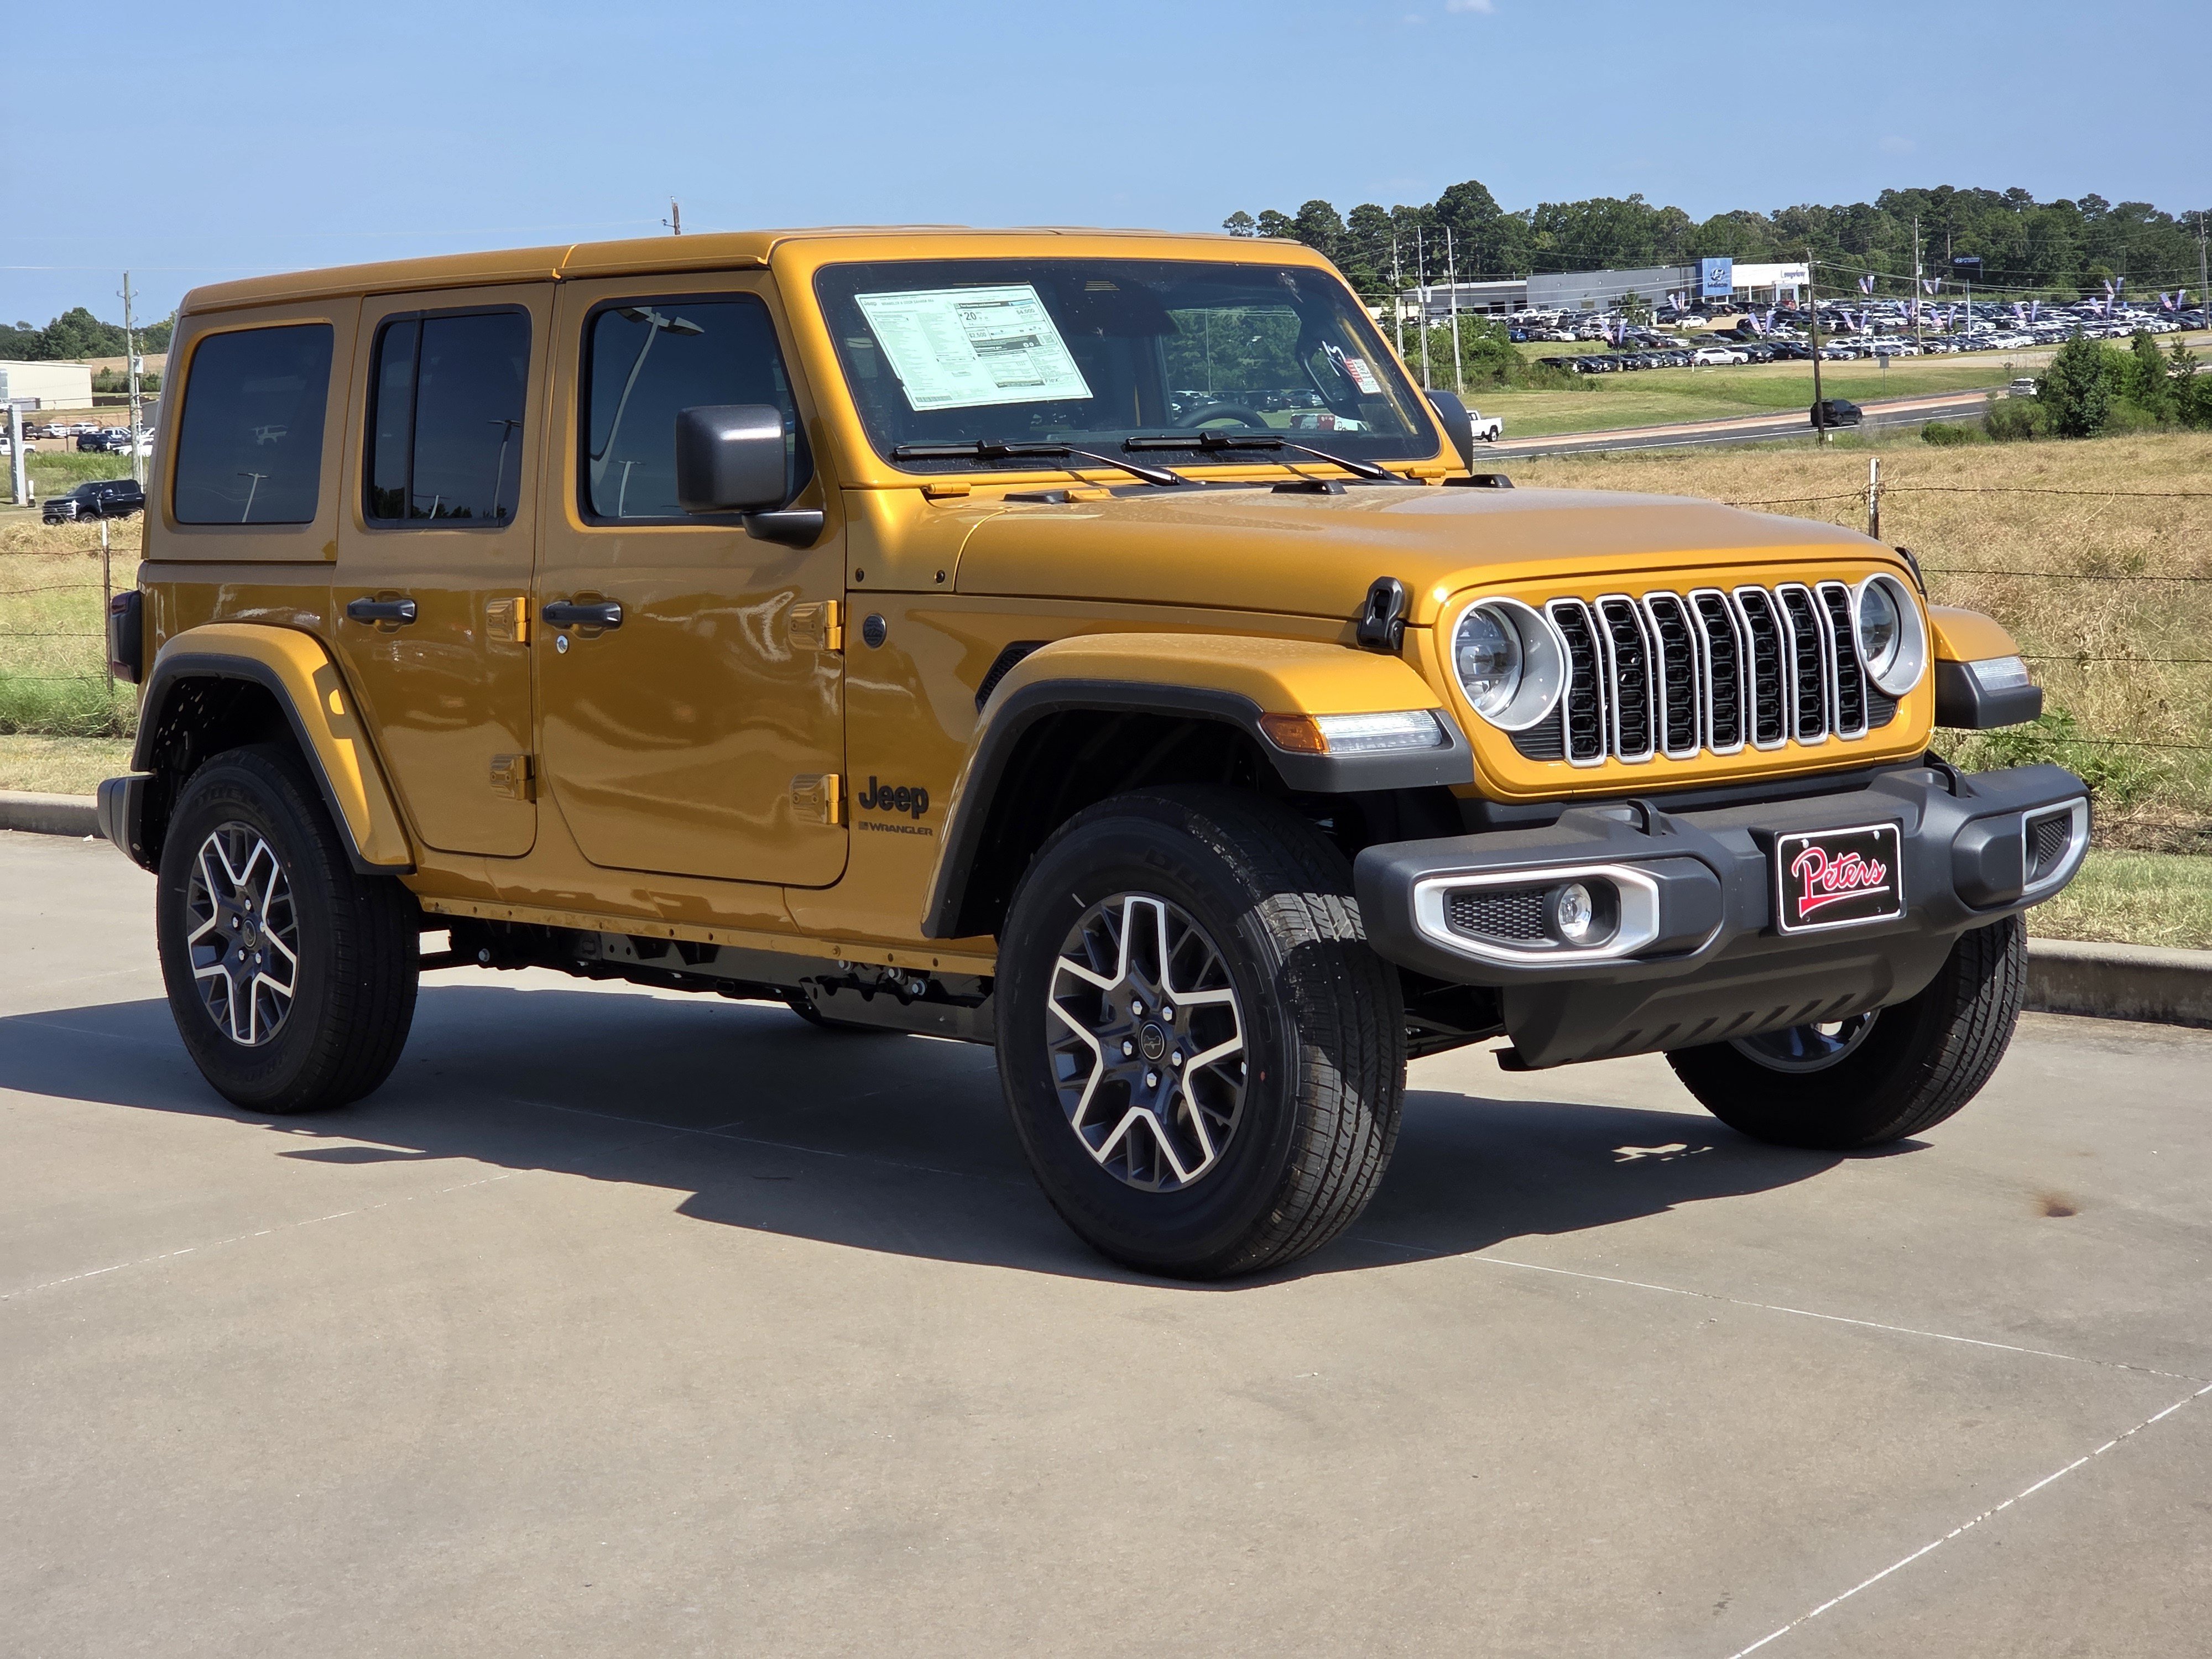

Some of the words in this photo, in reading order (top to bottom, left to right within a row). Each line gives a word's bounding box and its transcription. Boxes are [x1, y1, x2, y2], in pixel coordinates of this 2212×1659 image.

[963, 311, 977, 321] 20
[858, 775, 929, 820] Jeep
[869, 822, 933, 836] WRANGLER
[1791, 847, 1887, 902] Peters
